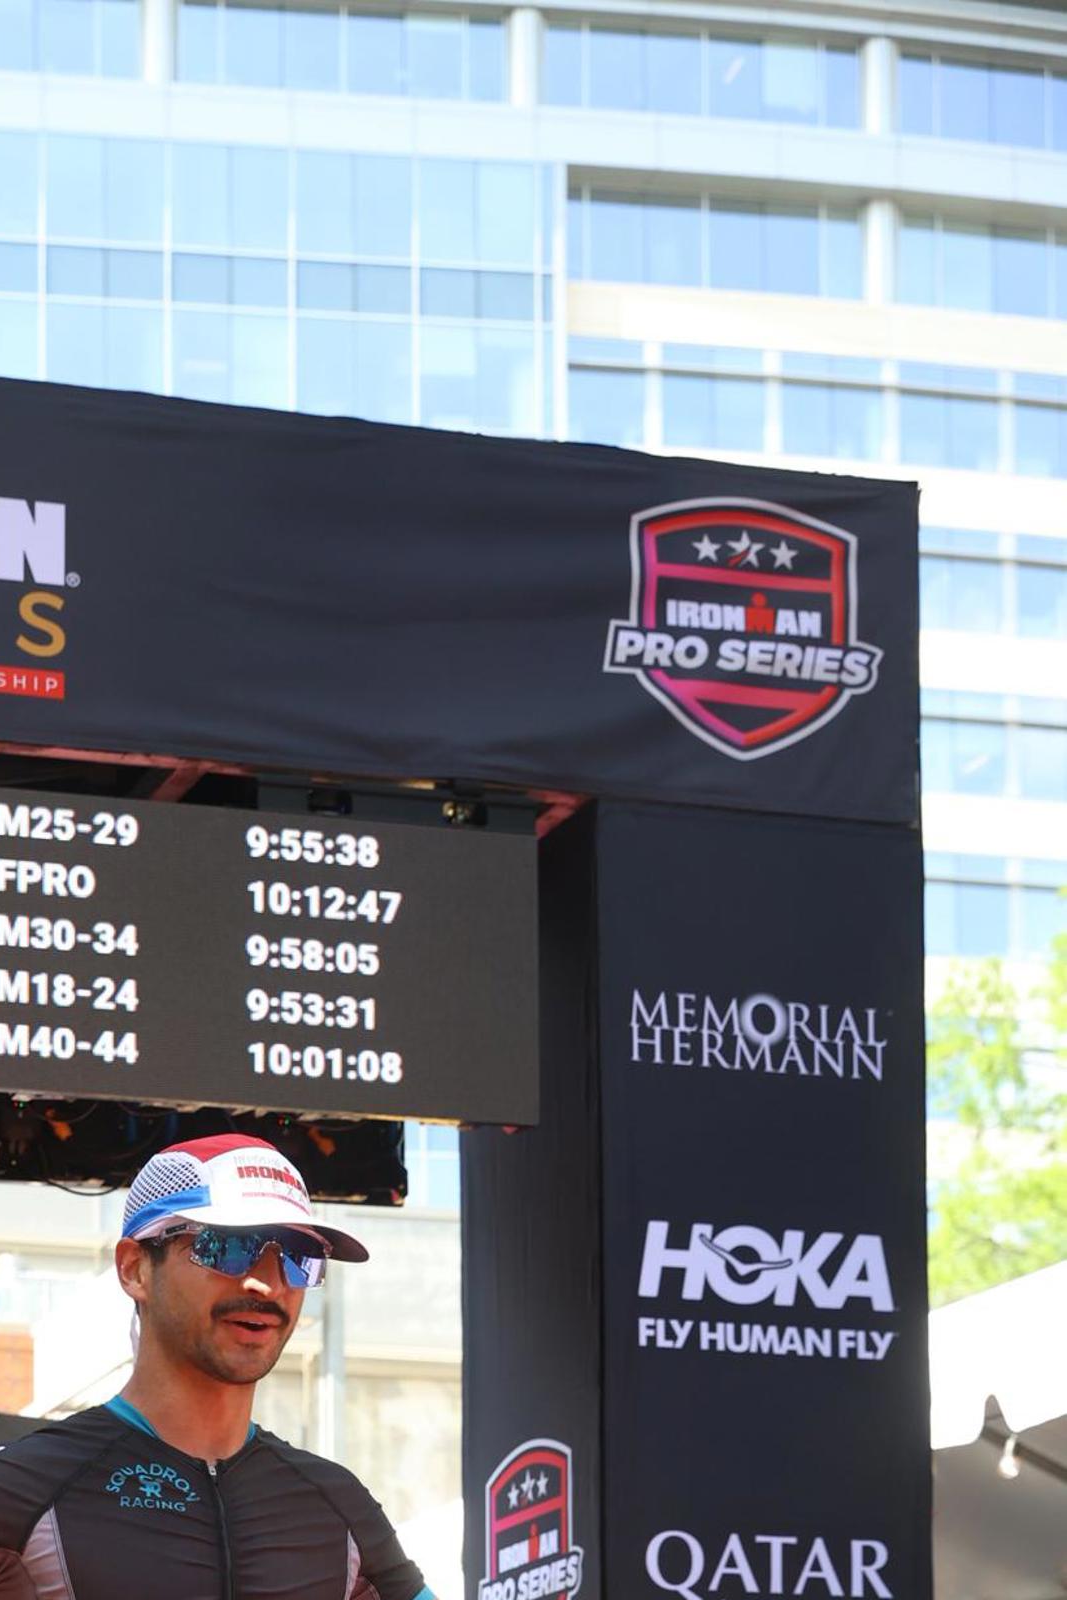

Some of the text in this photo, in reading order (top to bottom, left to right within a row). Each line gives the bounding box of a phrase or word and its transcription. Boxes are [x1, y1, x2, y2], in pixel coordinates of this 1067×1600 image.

[666, 592, 821, 638] IRONMAN
[614, 629, 871, 686] PRO SERIES
[245, 825, 379, 869] 9:55:38
[246, 880, 402, 925] 10:12:47
[245, 934, 379, 977] 9:58:05
[245, 988, 376, 1032] 9:53:31
[630, 988, 888, 1046] MEMORIAL
[246, 1041, 402, 1084] 10:01:08
[631, 1025, 884, 1081] HERMANN
[638, 1220, 894, 1313] HOKA
[638, 1317, 893, 1361] FLY HUMAN FLY
[105, 1462, 200, 1502] SQUADRON
[120, 1495, 186, 1512] RACING
